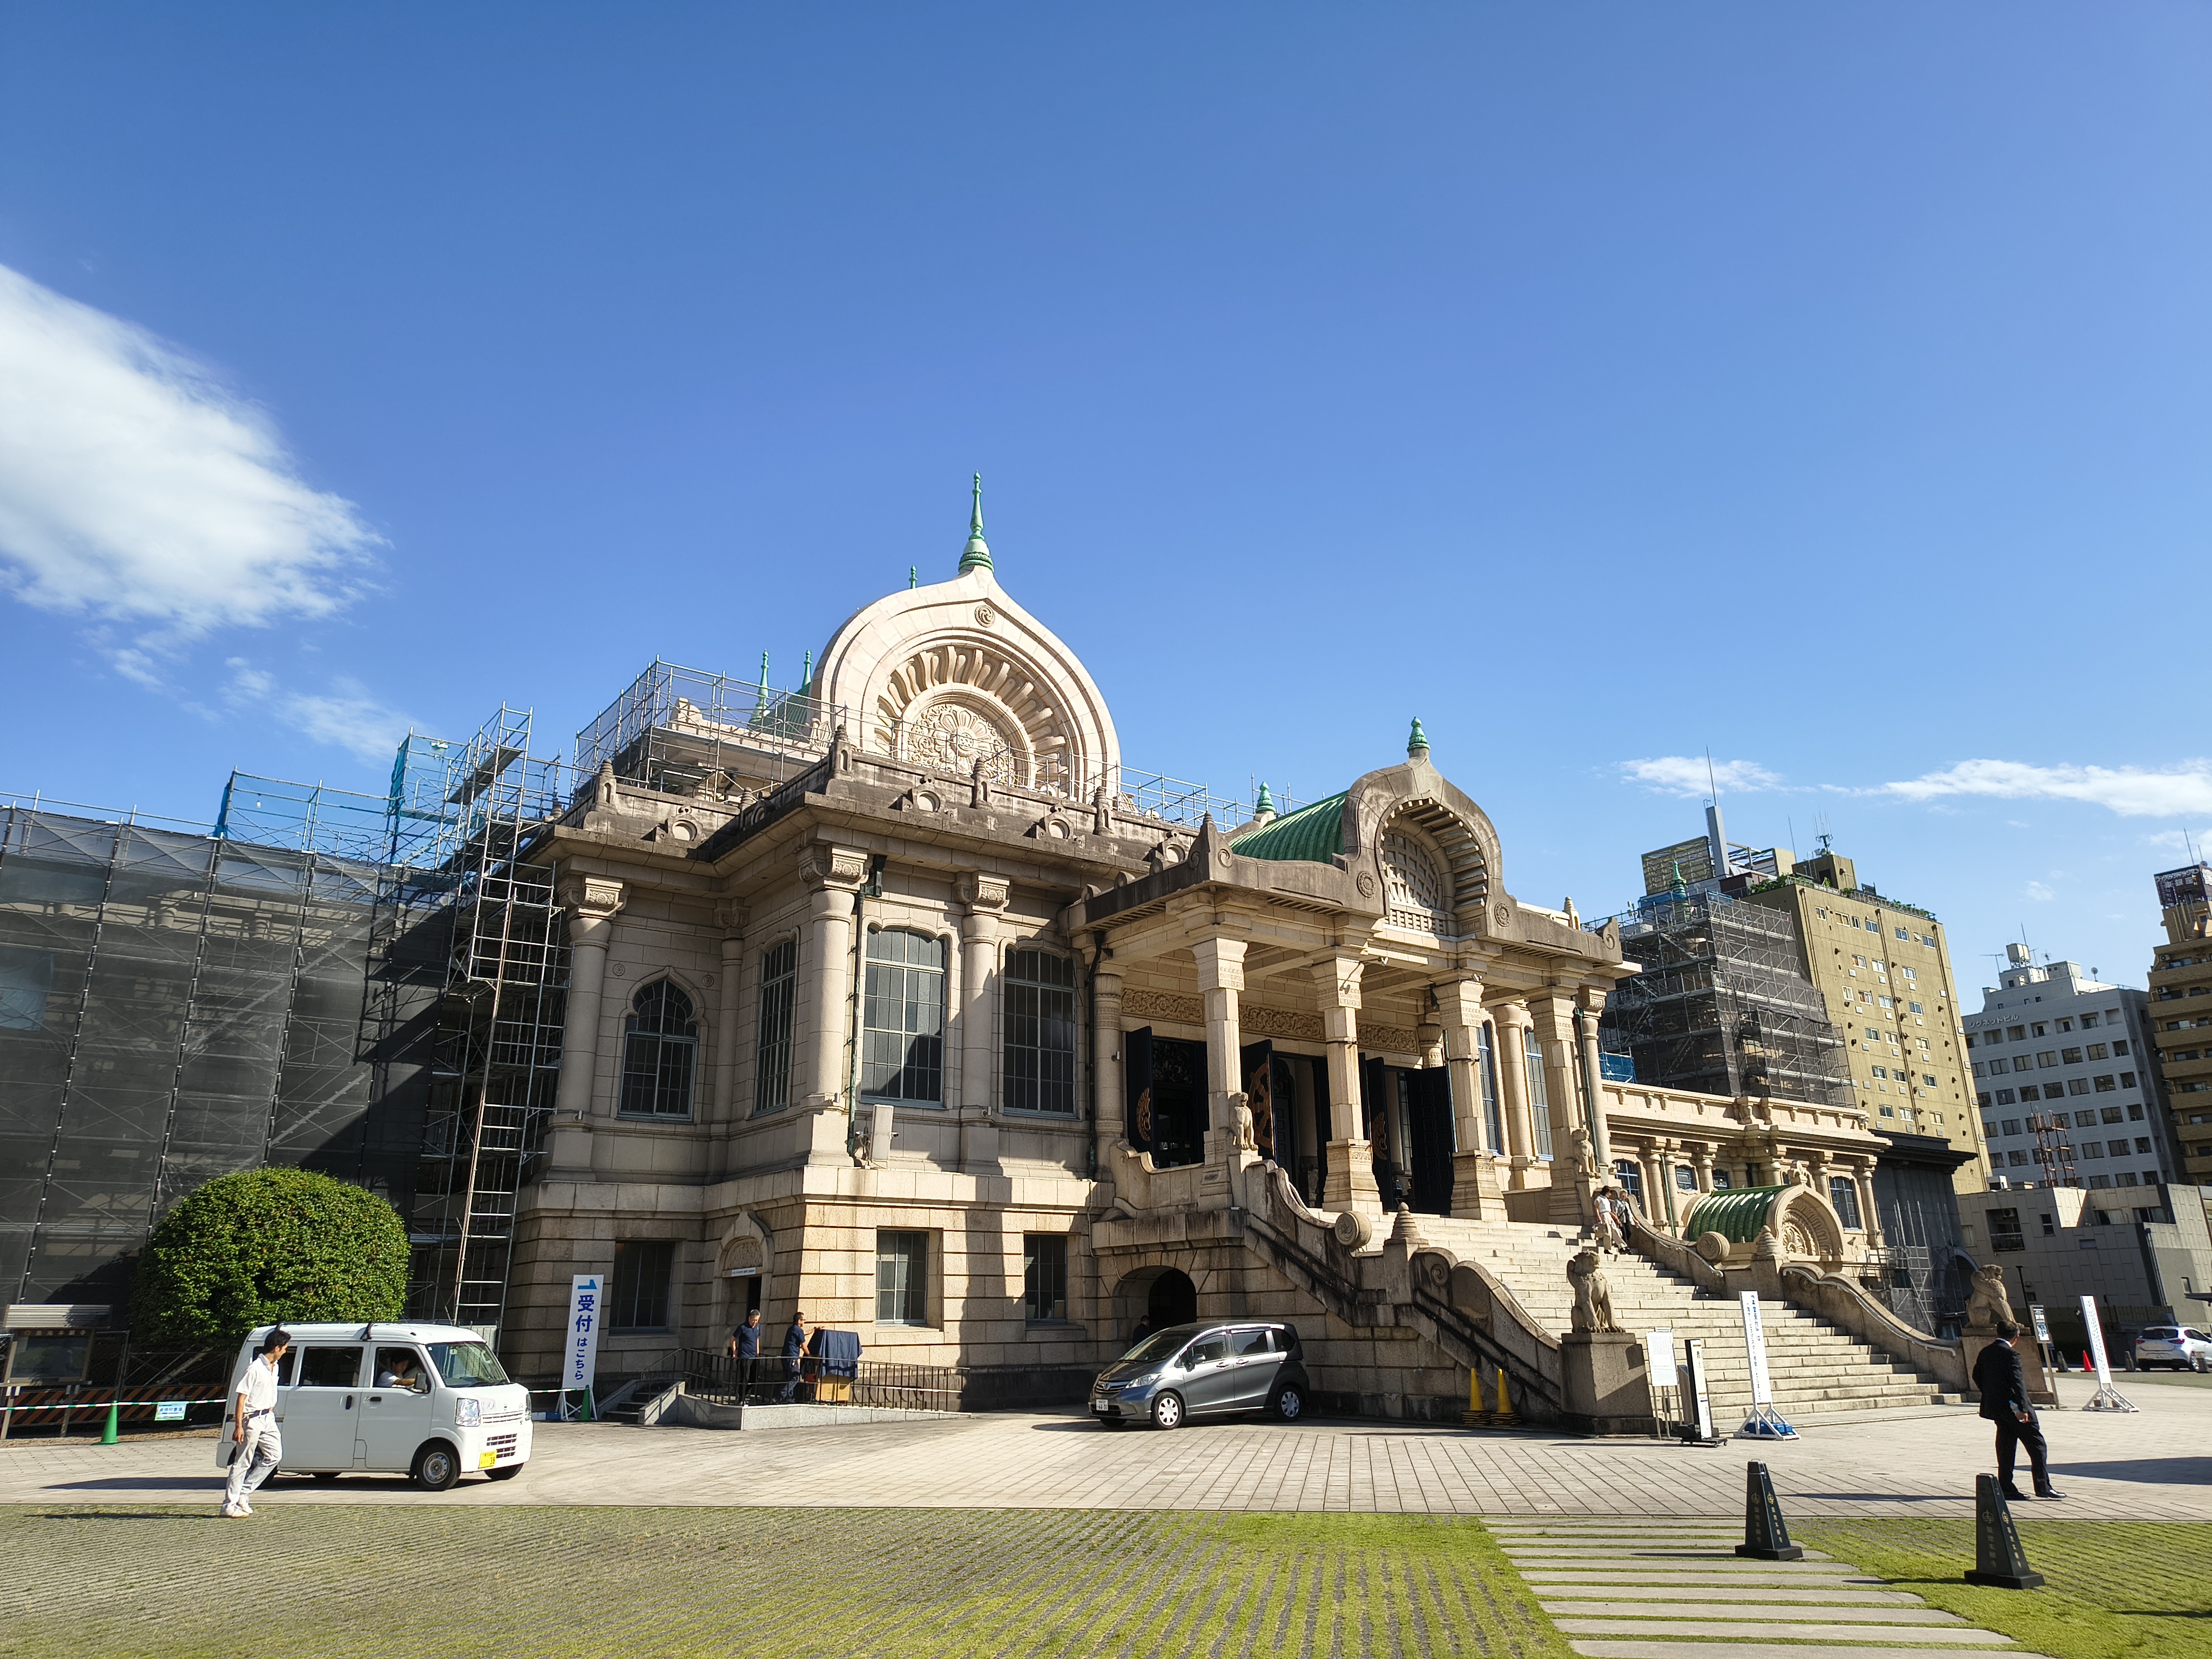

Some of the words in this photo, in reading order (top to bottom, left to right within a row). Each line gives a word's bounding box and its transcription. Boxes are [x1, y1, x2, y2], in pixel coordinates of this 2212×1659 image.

[575, 1294, 595, 1380] 受付はこちら
